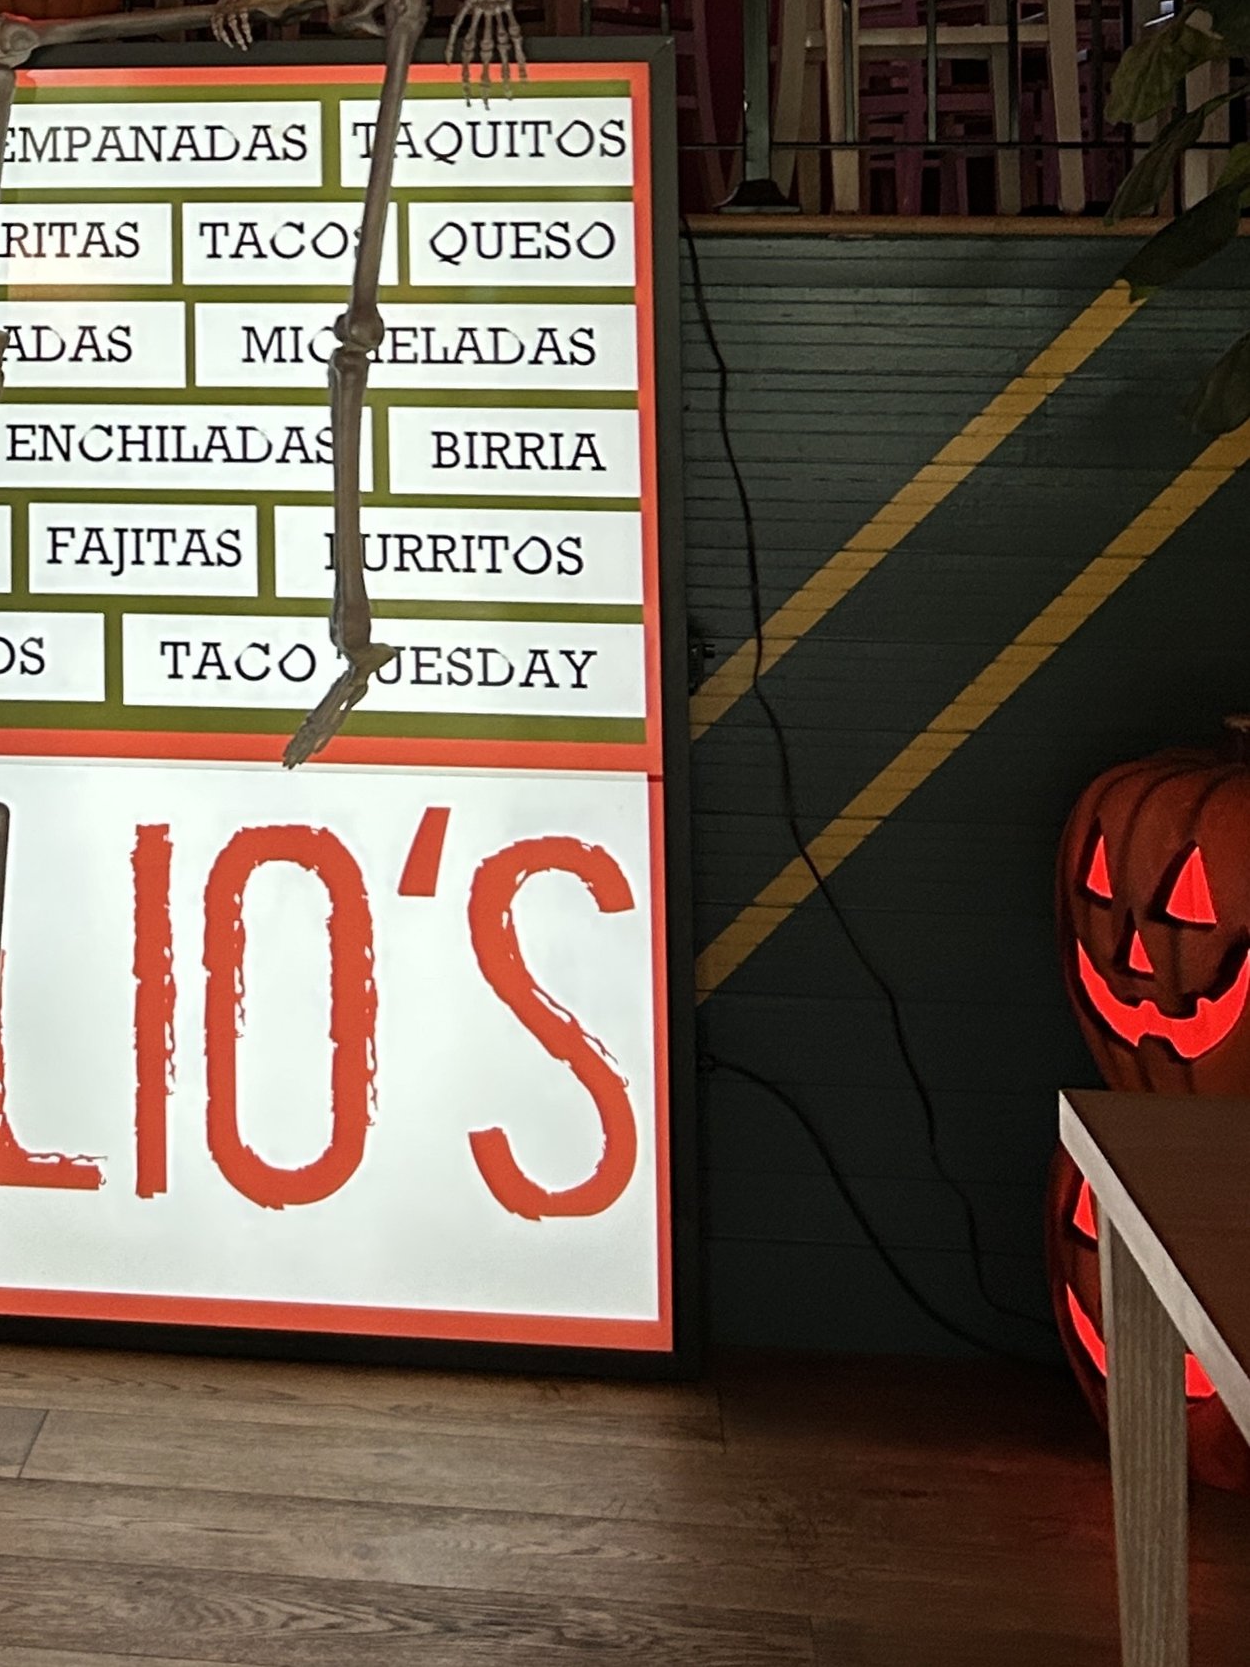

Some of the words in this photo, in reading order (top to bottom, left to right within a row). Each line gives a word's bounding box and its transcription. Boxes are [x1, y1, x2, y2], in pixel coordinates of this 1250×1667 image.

[352, 119, 626, 165] TAQUITOS
[199, 221, 363, 260] TACO
[429, 221, 616, 266] QUESO
[241, 325, 596, 367] MICELADAS
[6, 424, 336, 463] ENCHILADAS
[431, 431, 607, 472] BIRRIA
[46, 526, 242, 577] FAJITAS
[160, 641, 317, 683] TACO
[336, 646, 598, 689] UESDAY
